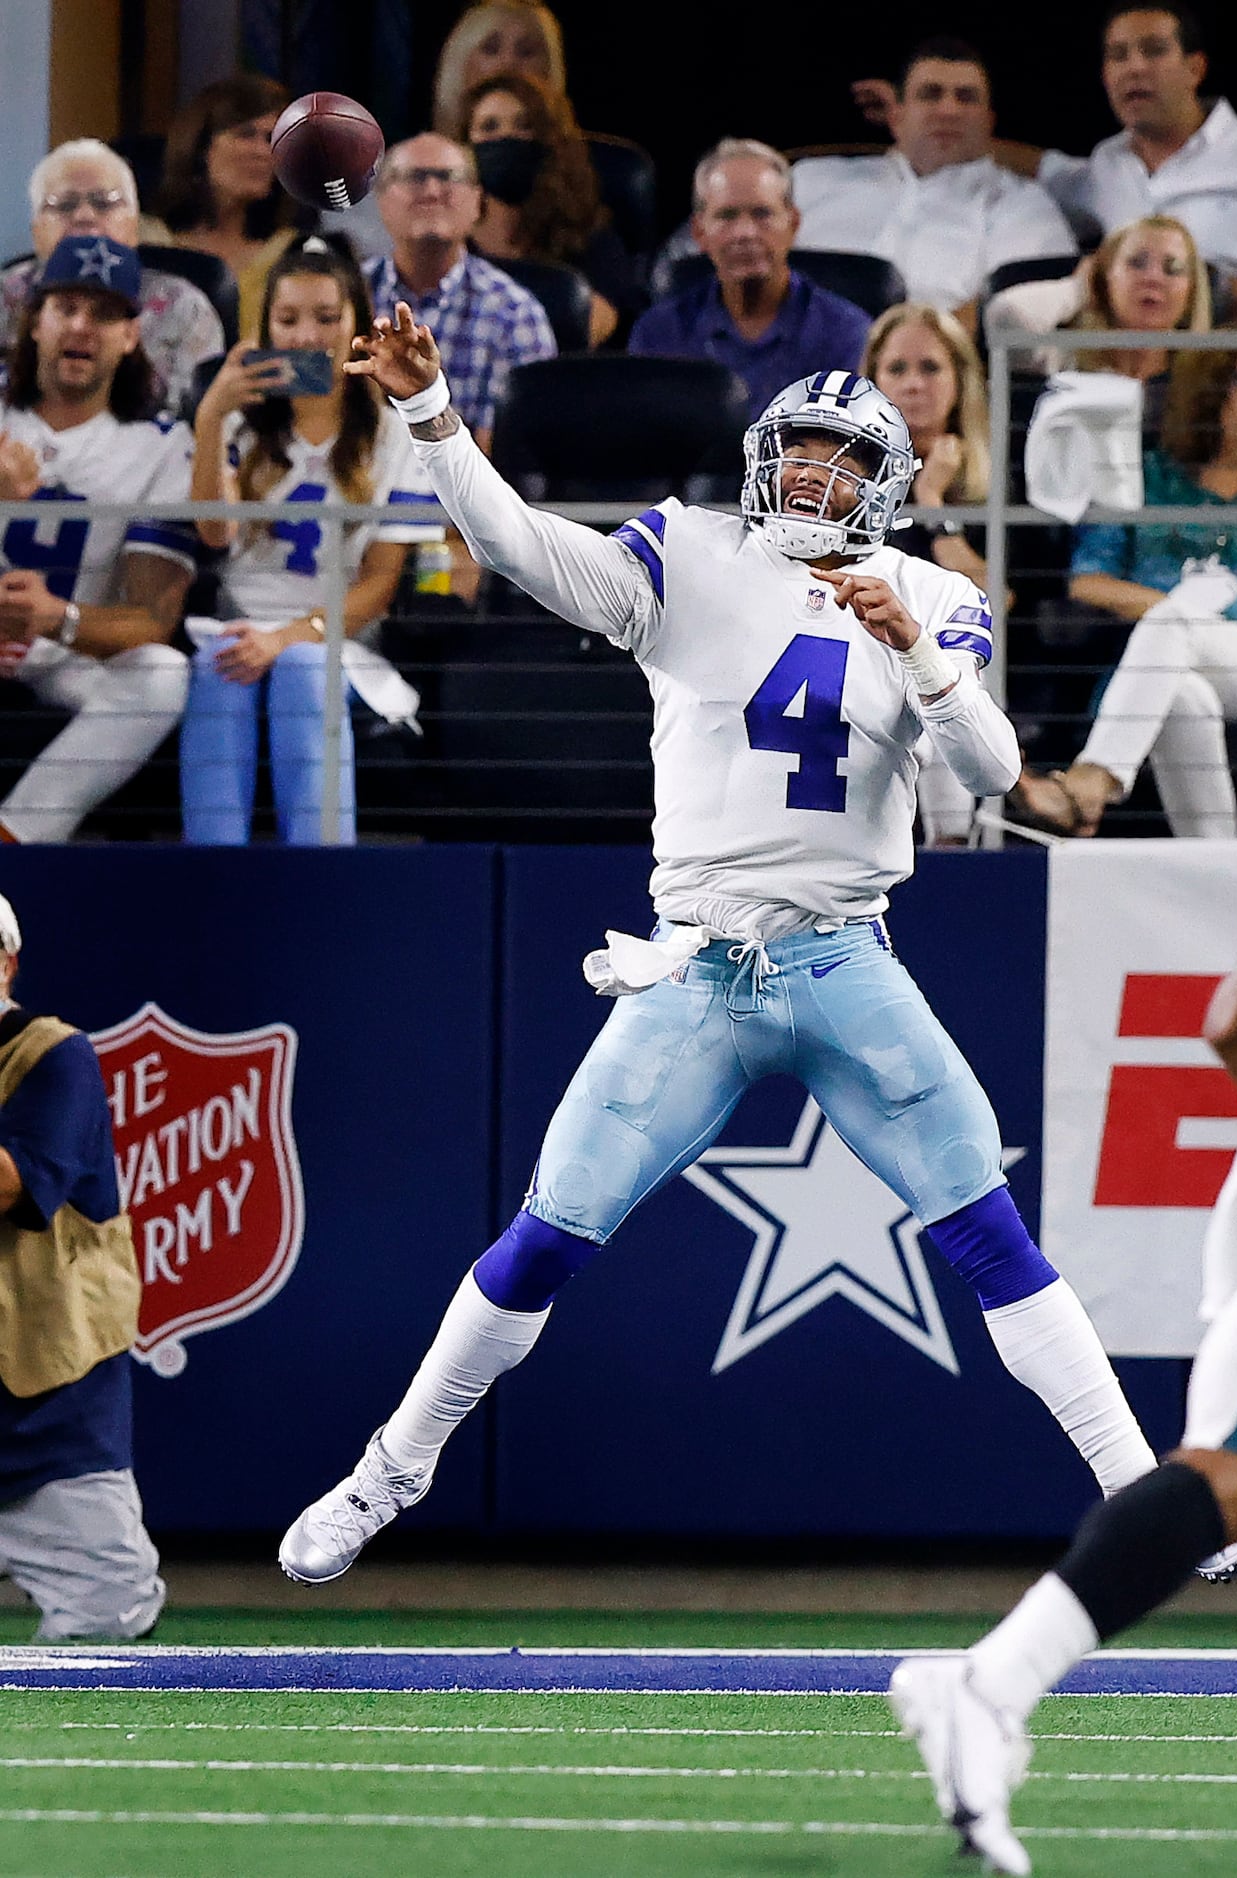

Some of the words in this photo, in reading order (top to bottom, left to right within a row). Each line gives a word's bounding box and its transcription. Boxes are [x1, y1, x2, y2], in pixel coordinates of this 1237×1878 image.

[743, 633, 850, 814] 4
[107, 1051, 168, 1128] HE
[114, 1067, 261, 1210] VATION
[144, 1159, 255, 1285] RMY
